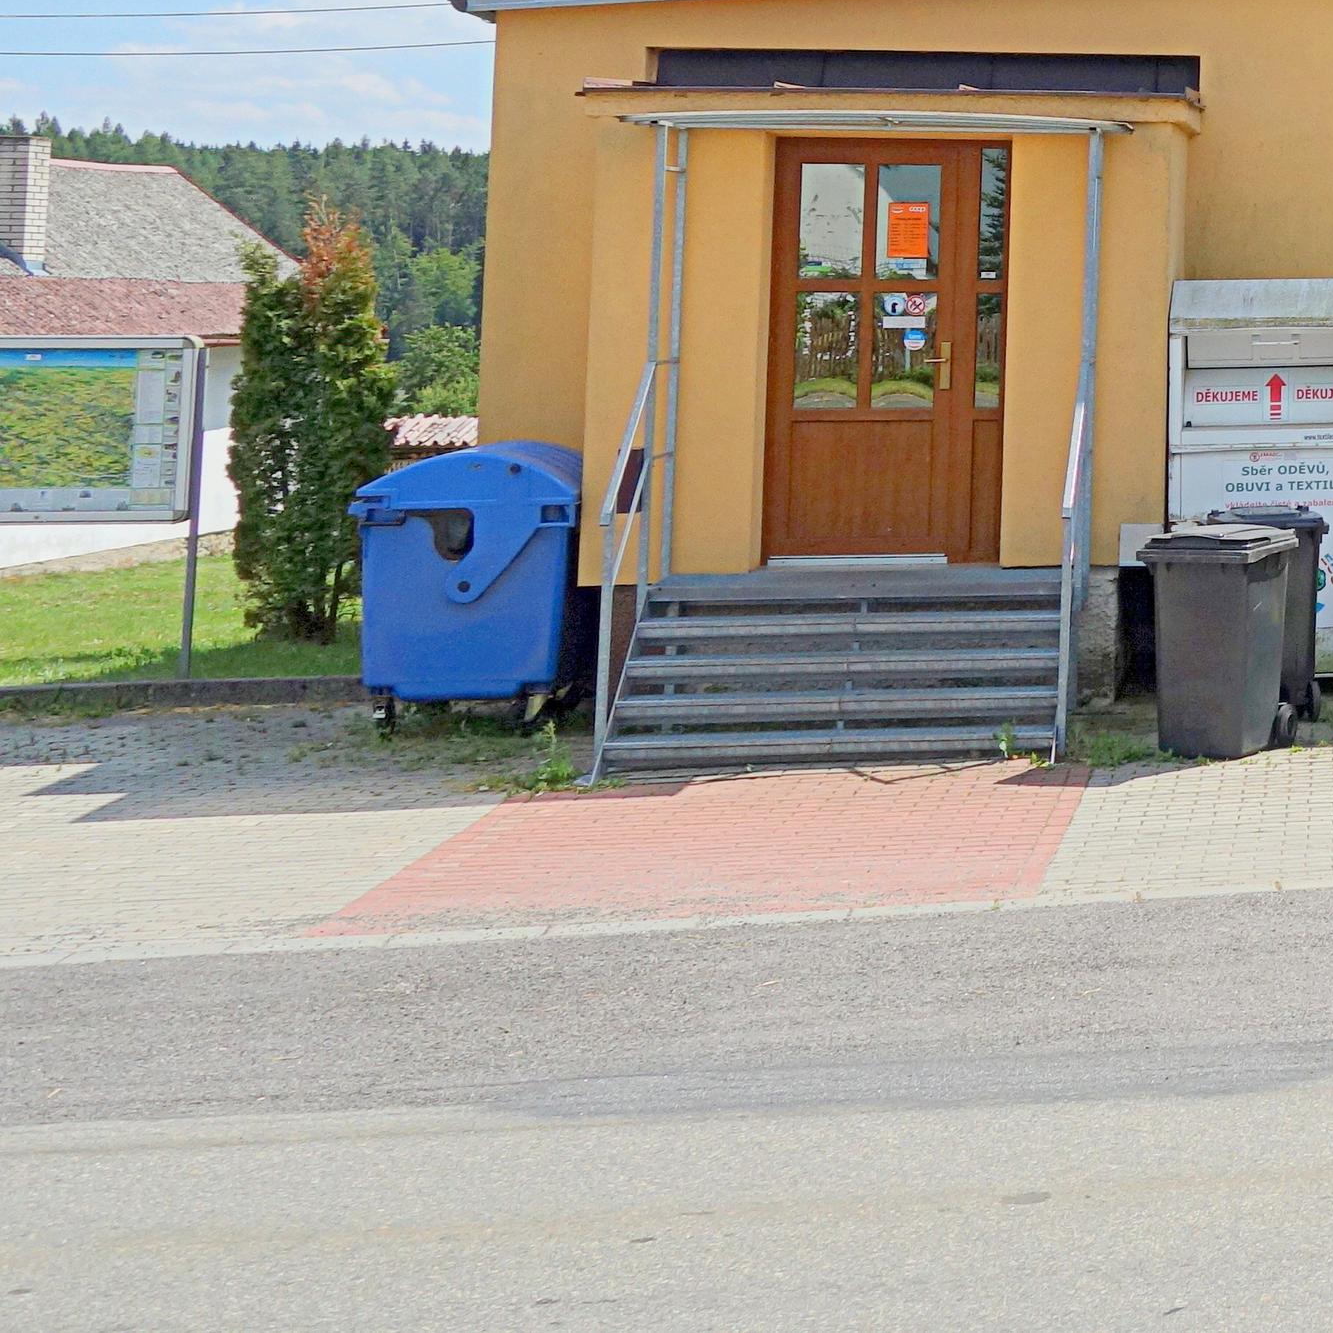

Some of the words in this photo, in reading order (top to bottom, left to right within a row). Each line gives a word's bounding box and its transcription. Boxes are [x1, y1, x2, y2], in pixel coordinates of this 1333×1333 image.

[1195, 389, 1259, 402] DĚKUJEME
[1241, 465, 1273, 476] Sběr
[1277, 461, 1329, 476] ODĚVŮ,
[1225, 482, 1271, 492] OBUVI
[1275, 483, 1283, 491] a
